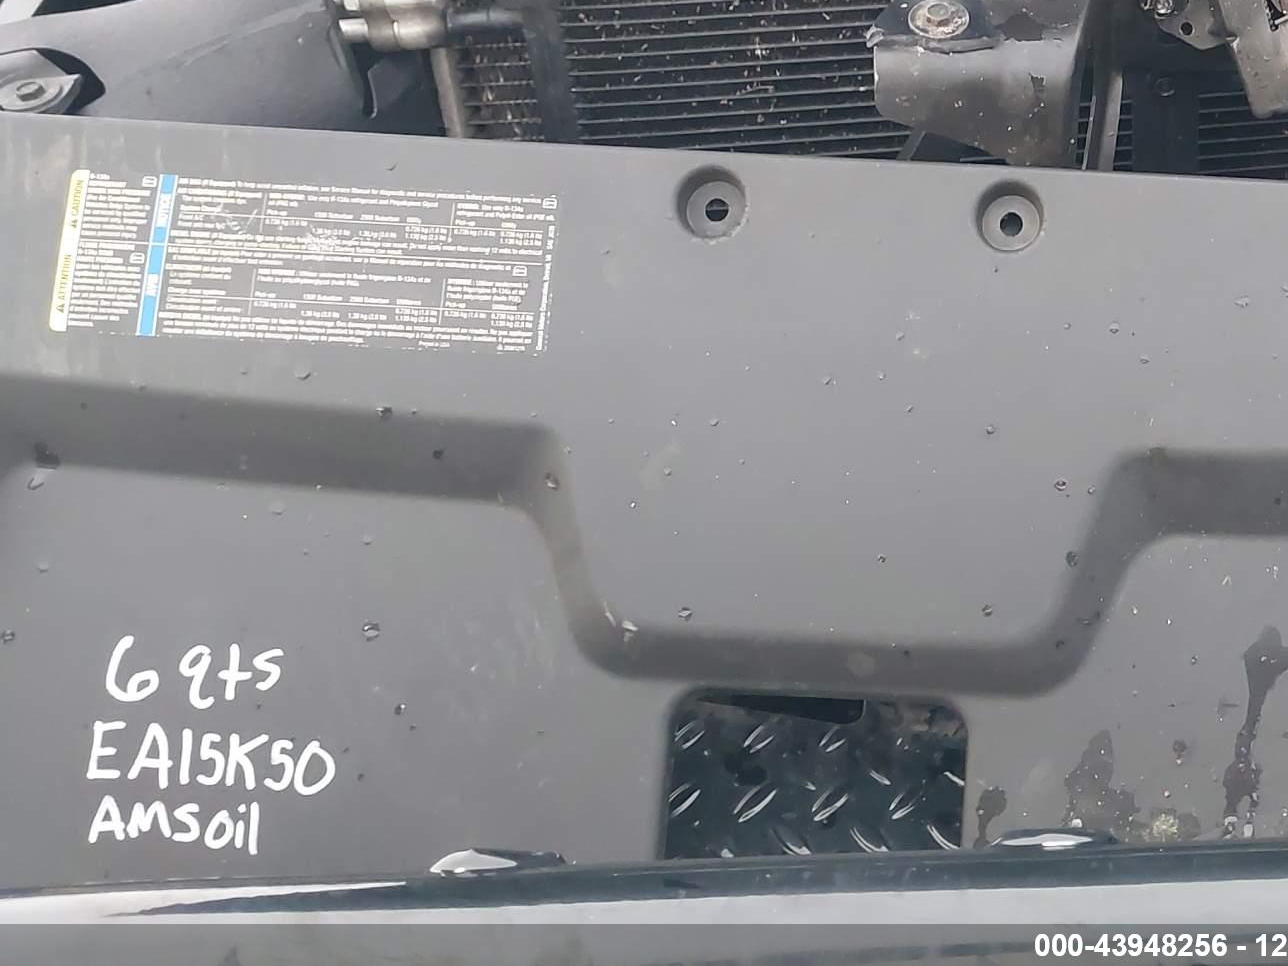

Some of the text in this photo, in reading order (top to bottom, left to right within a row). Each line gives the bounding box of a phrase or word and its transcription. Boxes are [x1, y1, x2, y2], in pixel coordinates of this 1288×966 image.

[72, 180, 84, 217] CAUTION
[58, 254, 72, 300] ATTENTION
[106, 636, 159, 701] 6
